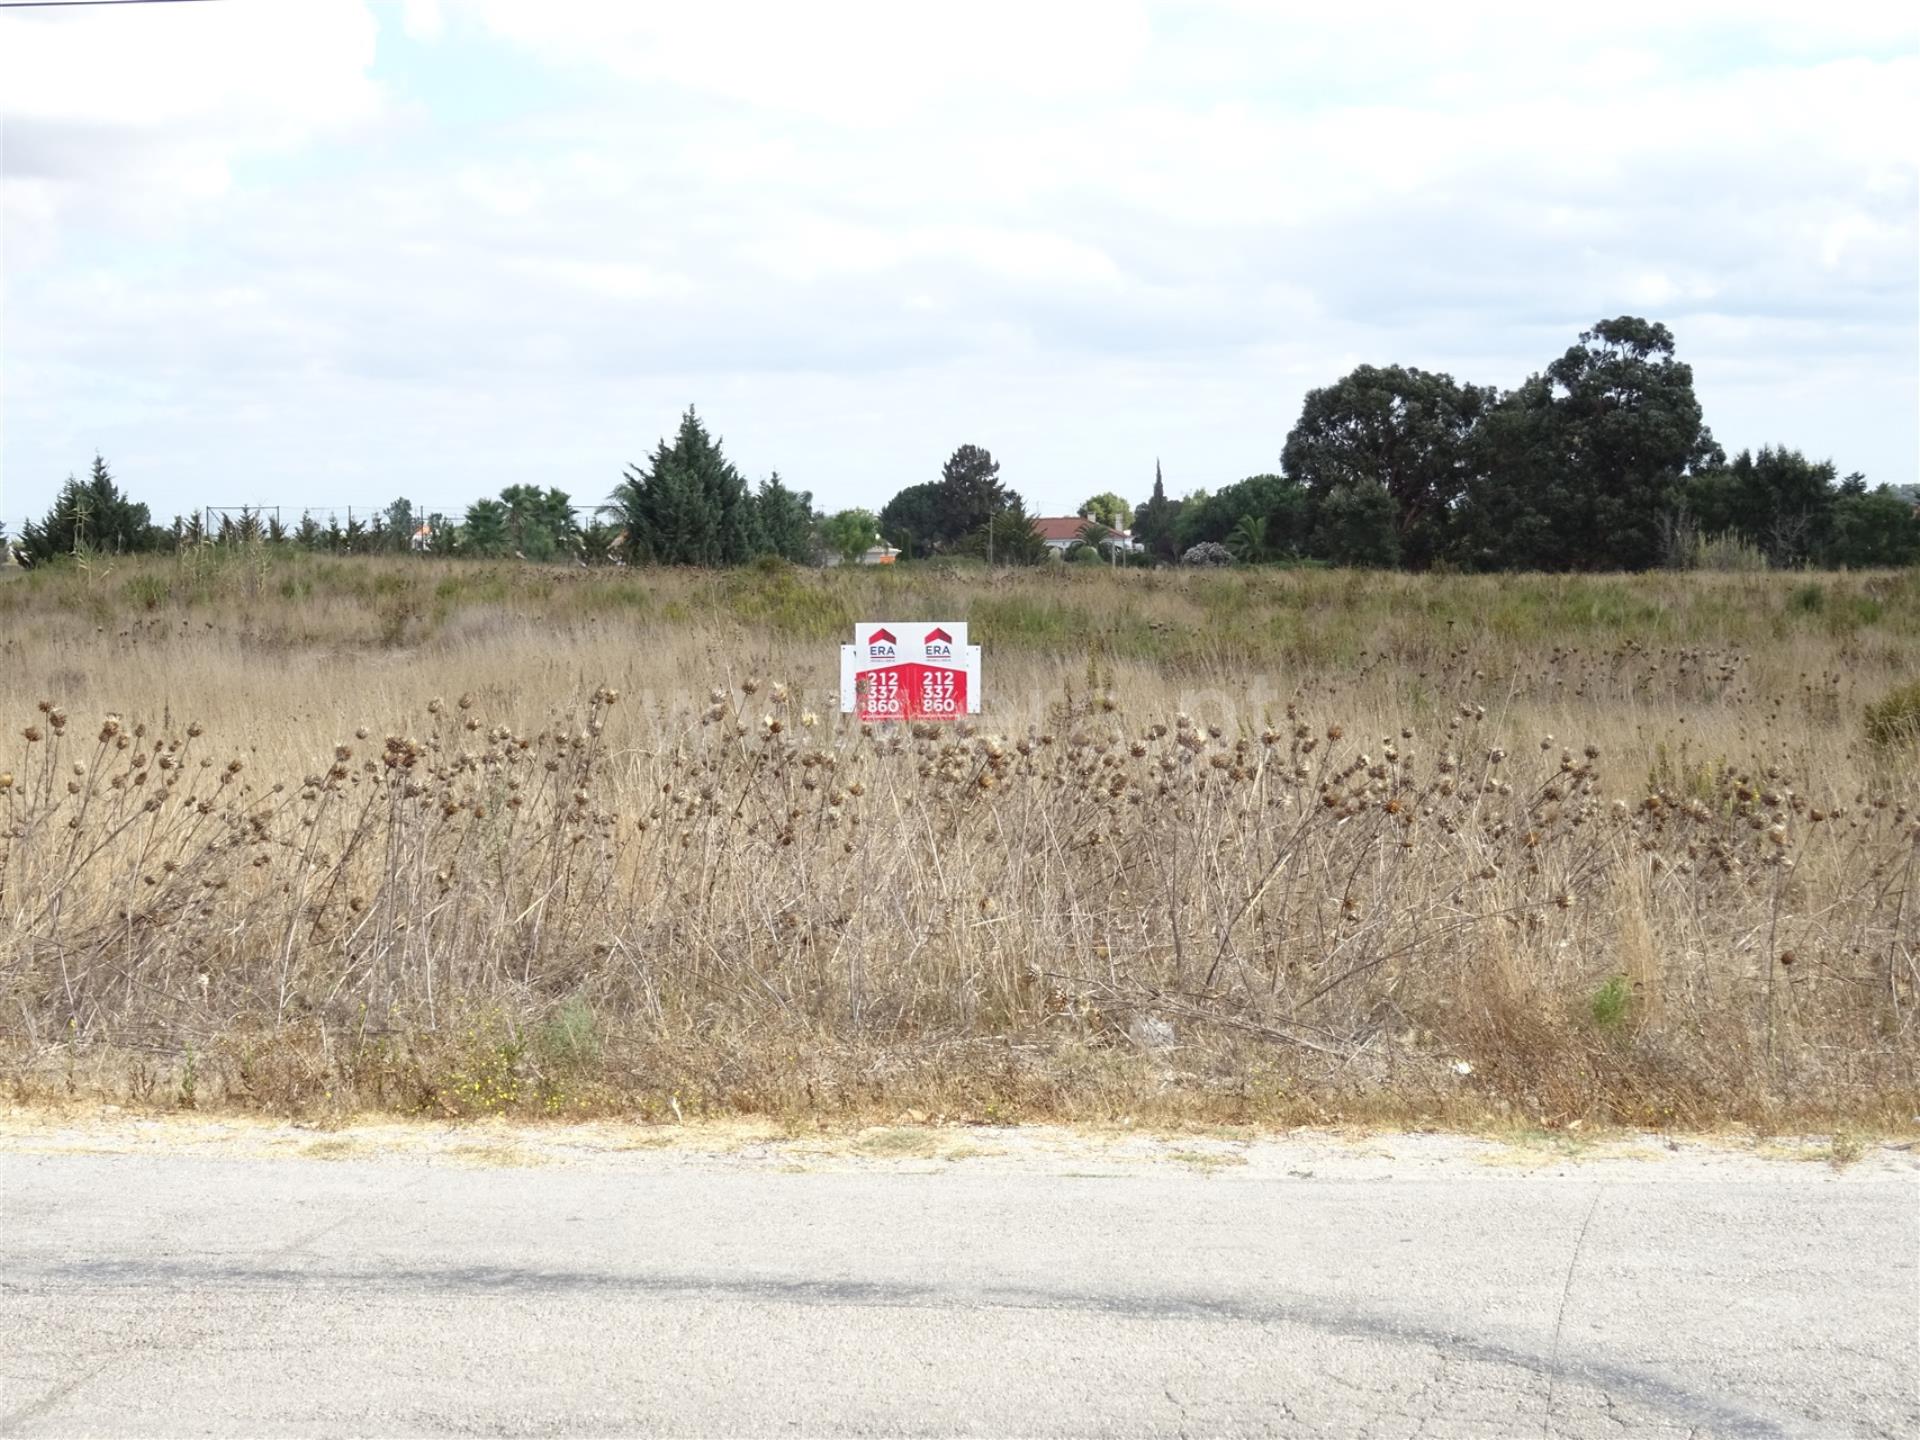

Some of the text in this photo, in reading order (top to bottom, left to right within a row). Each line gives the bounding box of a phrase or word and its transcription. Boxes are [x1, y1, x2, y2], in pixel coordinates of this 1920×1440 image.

[870, 646, 895, 656] ERA
[926, 645, 951, 655] ERA
[868, 672, 899, 686] 212
[923, 672, 954, 685] 212
[868, 686, 898, 699] 337
[923, 685, 954, 698] 337
[867, 699, 899, 713] 860
[923, 699, 955, 712] 860
